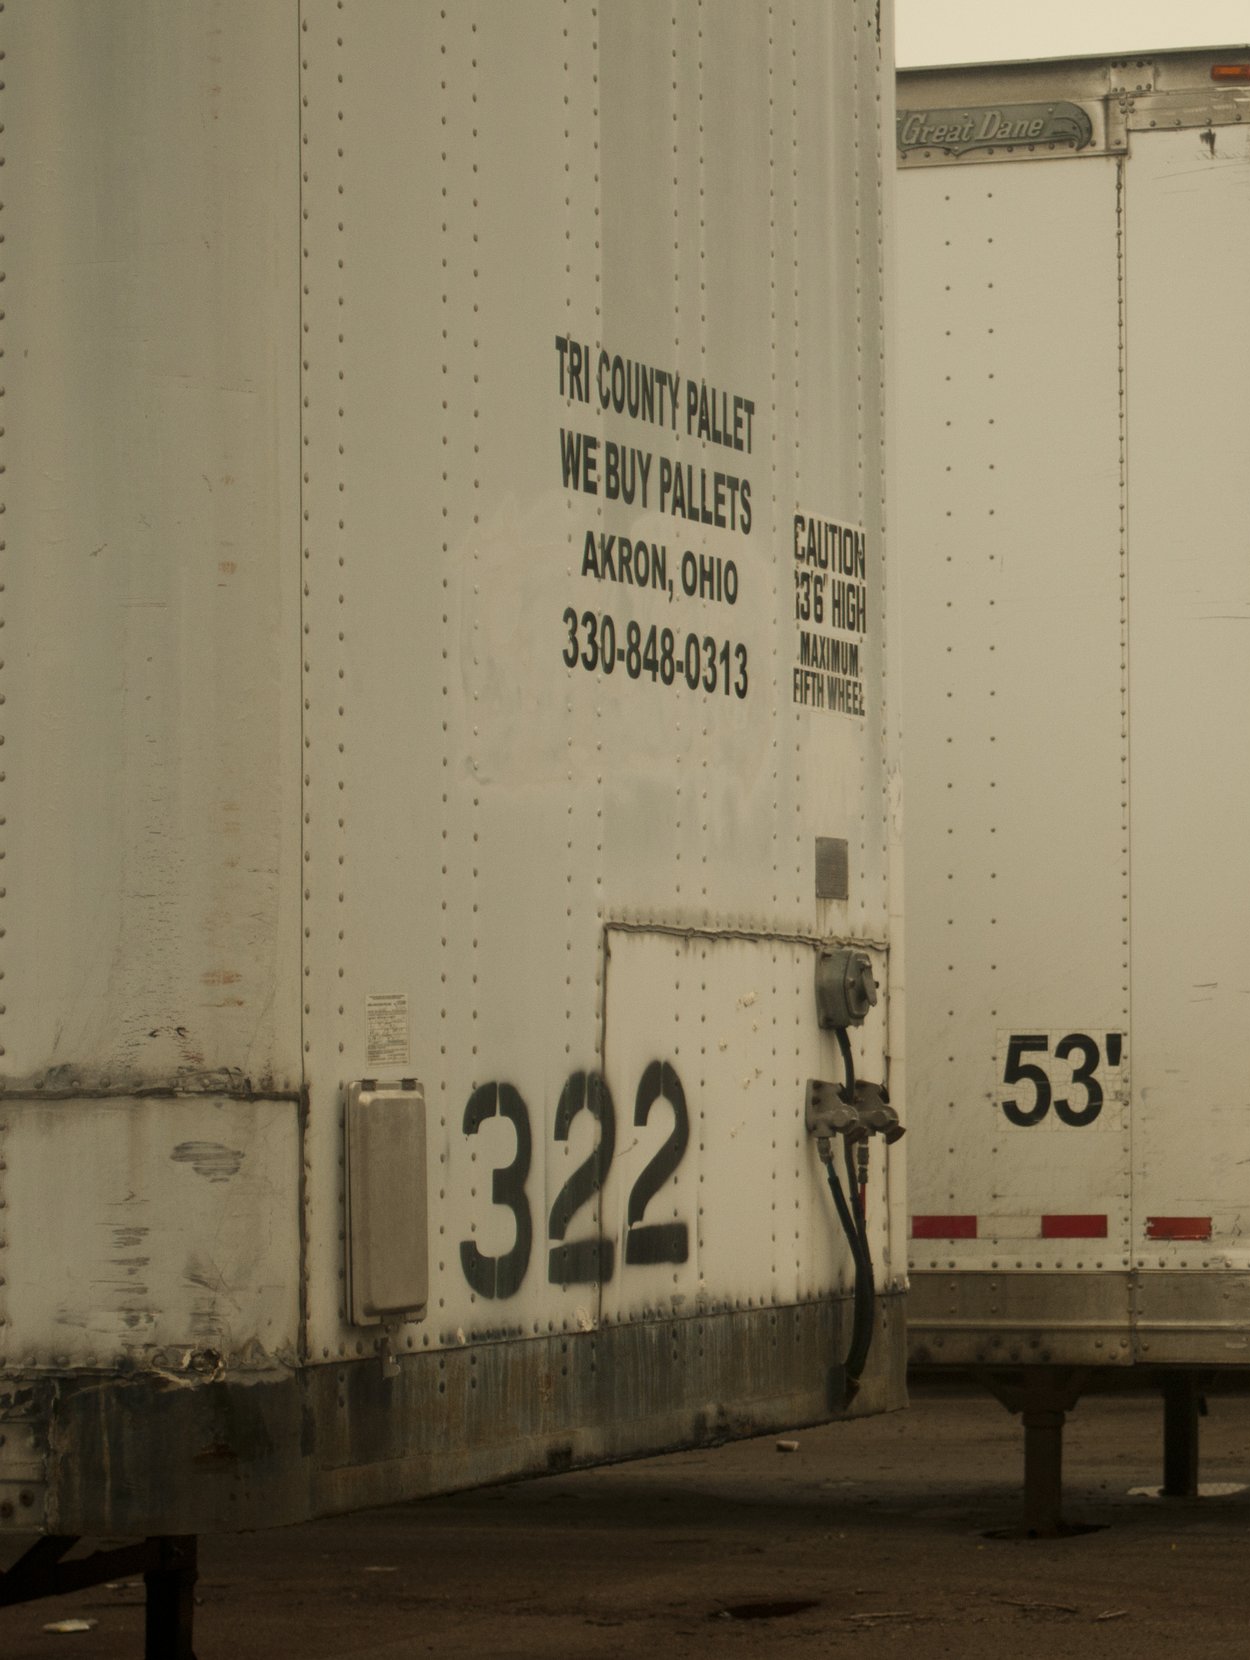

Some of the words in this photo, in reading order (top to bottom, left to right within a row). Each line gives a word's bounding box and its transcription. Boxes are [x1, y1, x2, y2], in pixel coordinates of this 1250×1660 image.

[901, 112, 975, 146] Great
[976, 109, 1044, 140] Dane
[555, 335, 590, 404] TRI
[598, 349, 680, 431] COUNTY
[687, 379, 755, 454] PALLET
[560, 427, 598, 496] WE
[605, 440, 652, 508] BUY
[659, 456, 752, 535] PALLETS
[581, 530, 674, 602] AKRON,
[681, 550, 739, 605] OHIO
[793, 514, 866, 580] CAUTION
[831, 578, 867, 634] HIGH
[562, 607, 748, 700] 330-848-0313
[799, 631, 859, 678] MAXIMUM
[793, 668, 824, 708] FIFTH
[826, 675, 866, 716] WHEEL
[1001, 1033, 1122, 1127] 53'
[459, 1060, 690, 1300] 322
